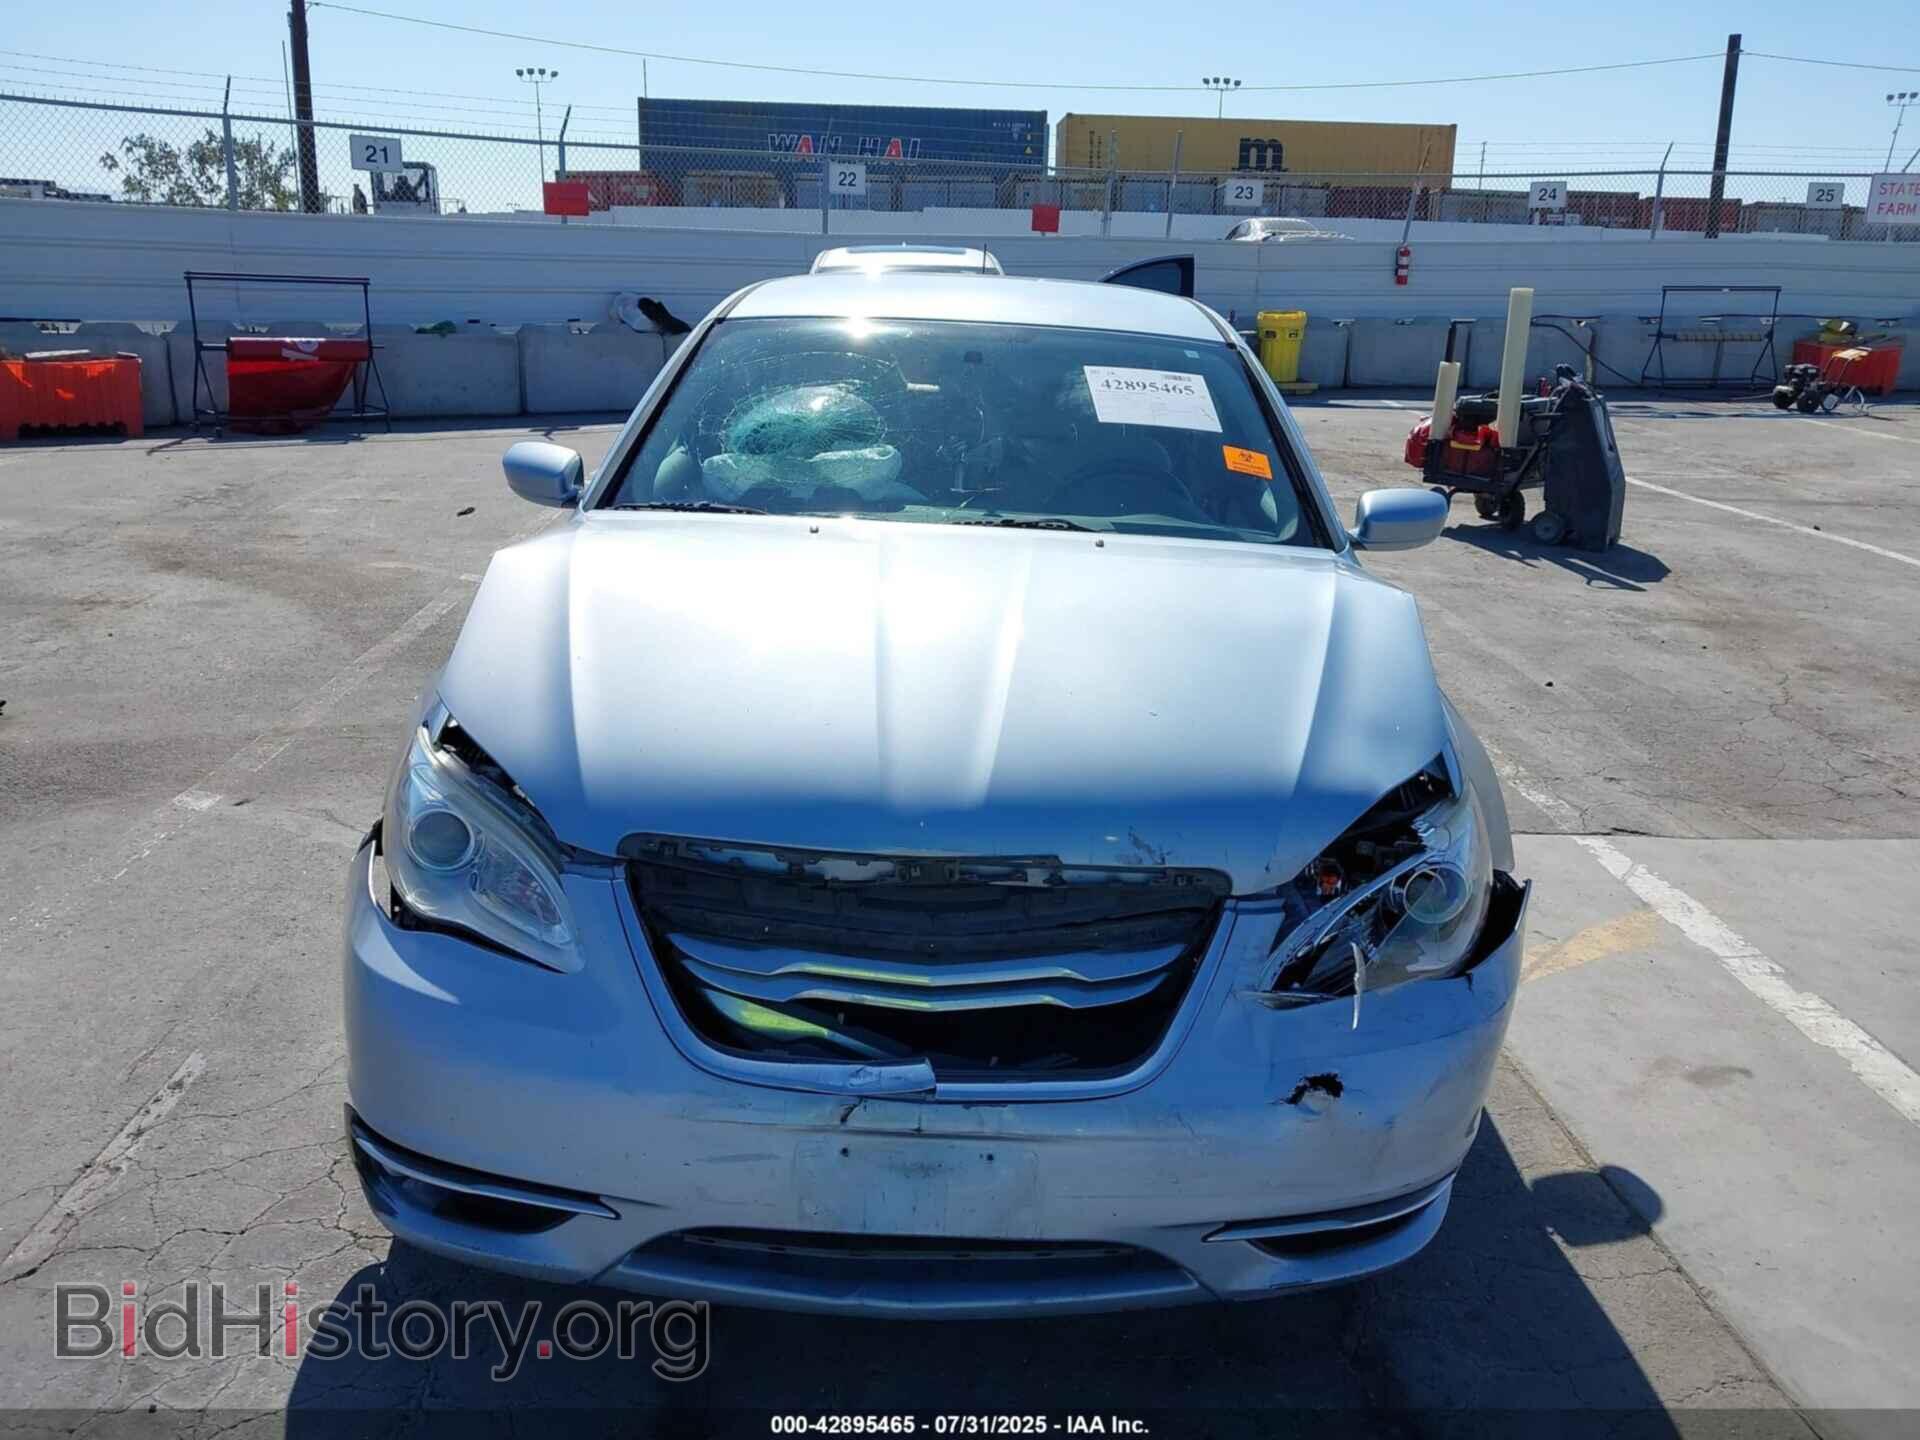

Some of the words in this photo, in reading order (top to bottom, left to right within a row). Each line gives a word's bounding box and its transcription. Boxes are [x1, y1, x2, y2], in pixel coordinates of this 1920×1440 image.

[365, 144, 389, 164] 21
[767, 133, 842, 163] WAN
[857, 135, 921, 166] HAI
[838, 171, 857, 187] 22
[1234, 185, 1254, 200] 23
[1538, 187, 1557, 201] 24
[1815, 188, 1836, 202] 25
[1879, 182, 1920, 197] STATE
[1876, 202, 1917, 217] FARM
[1101, 379, 1195, 396] 42895465
